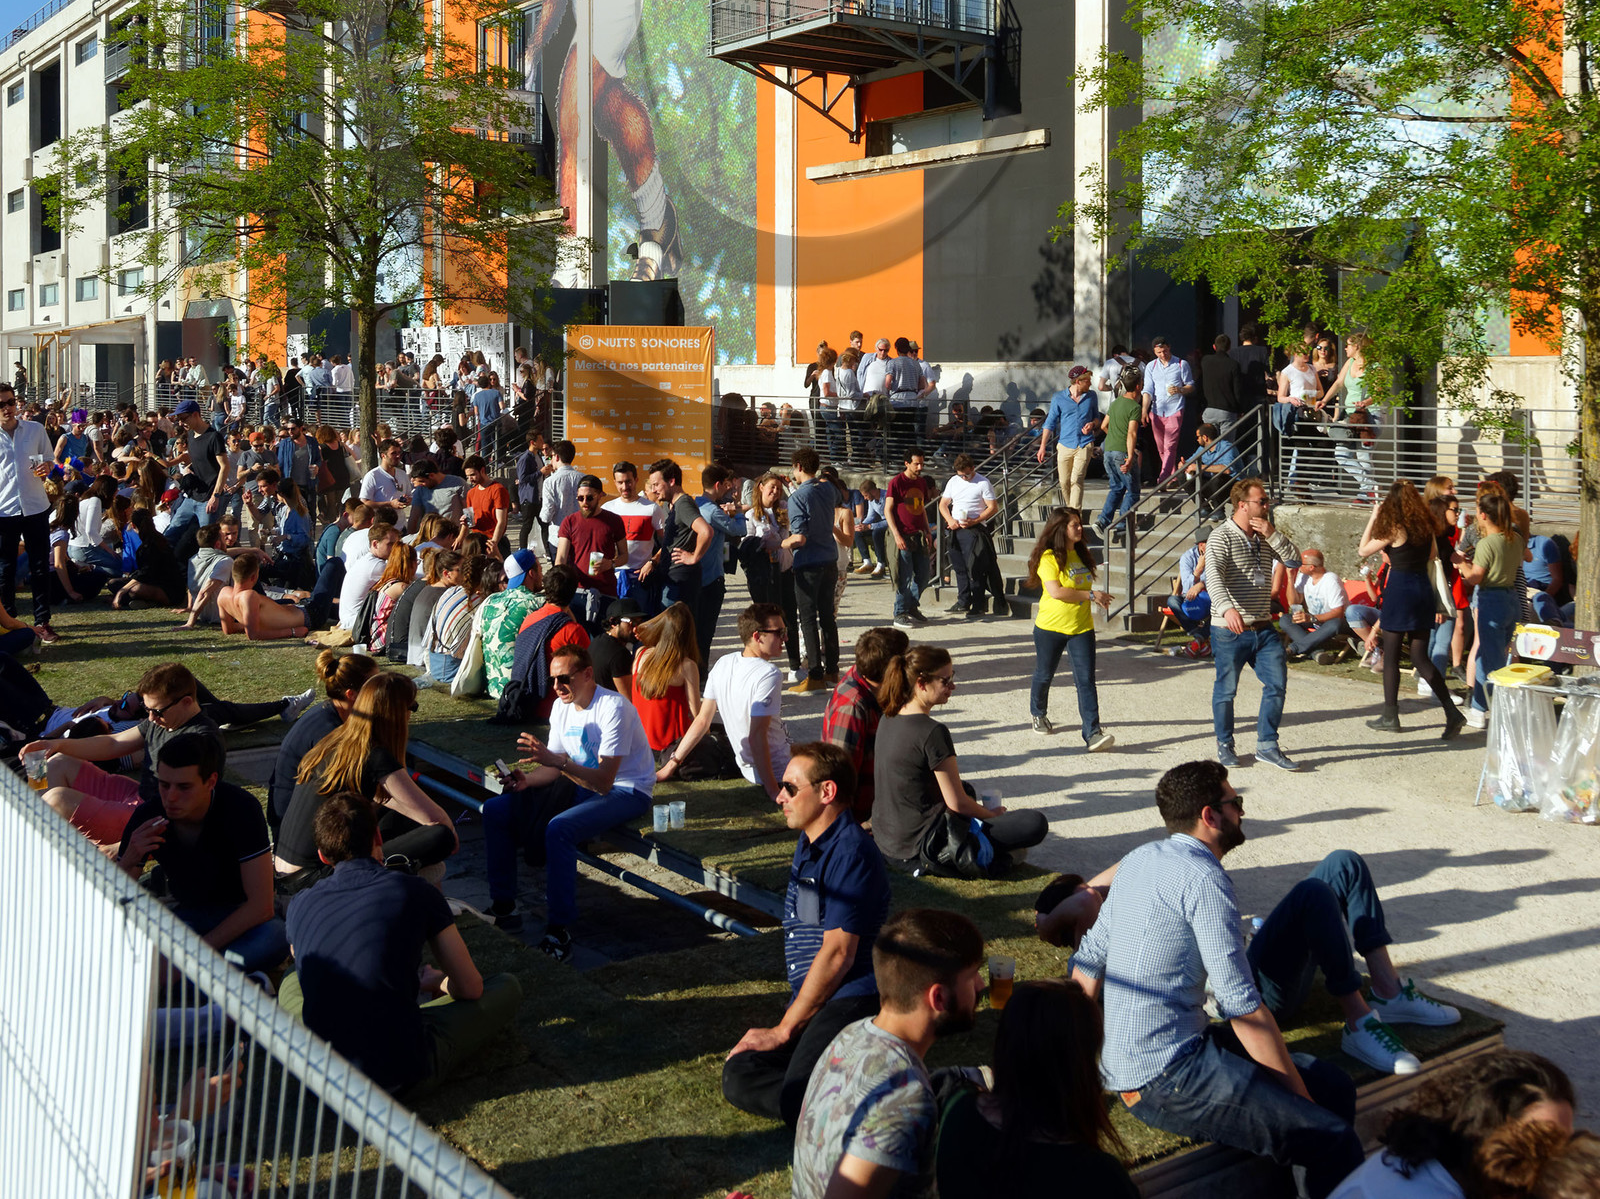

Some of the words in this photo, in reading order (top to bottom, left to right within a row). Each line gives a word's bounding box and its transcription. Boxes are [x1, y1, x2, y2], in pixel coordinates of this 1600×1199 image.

[597, 338, 636, 348] NUITS
[641, 338, 701, 348] SONORES
[574, 360, 607, 370] Merci
[609, 360, 617, 370] à
[619, 362, 639, 370] nos
[641, 360, 705, 372] partenaires
